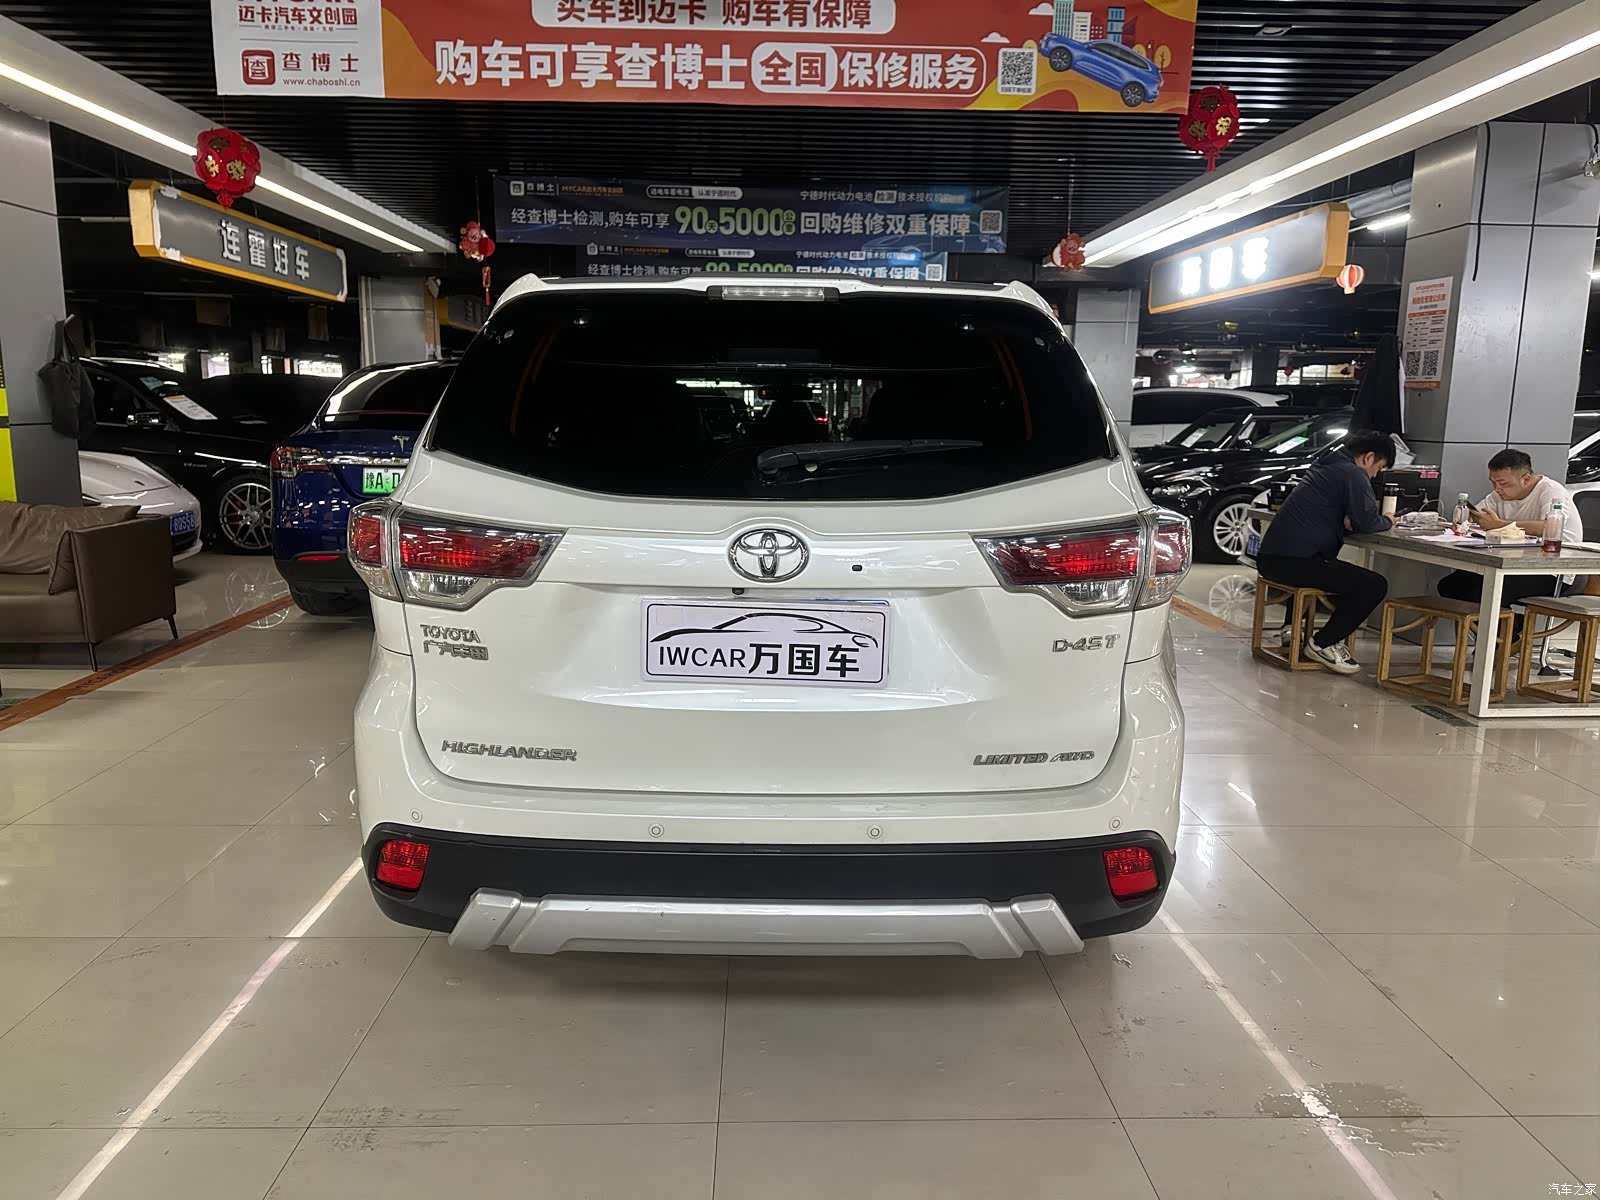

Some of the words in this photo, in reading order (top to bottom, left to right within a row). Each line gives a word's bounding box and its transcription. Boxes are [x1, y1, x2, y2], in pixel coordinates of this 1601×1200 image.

[238, 5, 358, 25] 迈卡汽车文创园
[556, 0, 706, 24] 买车到迈卡
[721, 0, 872, 29] 购车有保障
[282, 52, 359, 72] 查博士
[435, 39, 748, 91] 购车可享查博士
[759, 50, 827, 87] 全国
[839, 51, 978, 90] 保修服务
[283, 78, 361, 87] www.chaboshi.cn
[800, 211, 971, 236] 回购维修双重保障
[420, 624, 481, 643] TOYOTA
[441, 739, 578, 762] HIGHLANDER
[973, 752, 1048, 766] LIMITED
[1049, 750, 1095, 762] AWD
